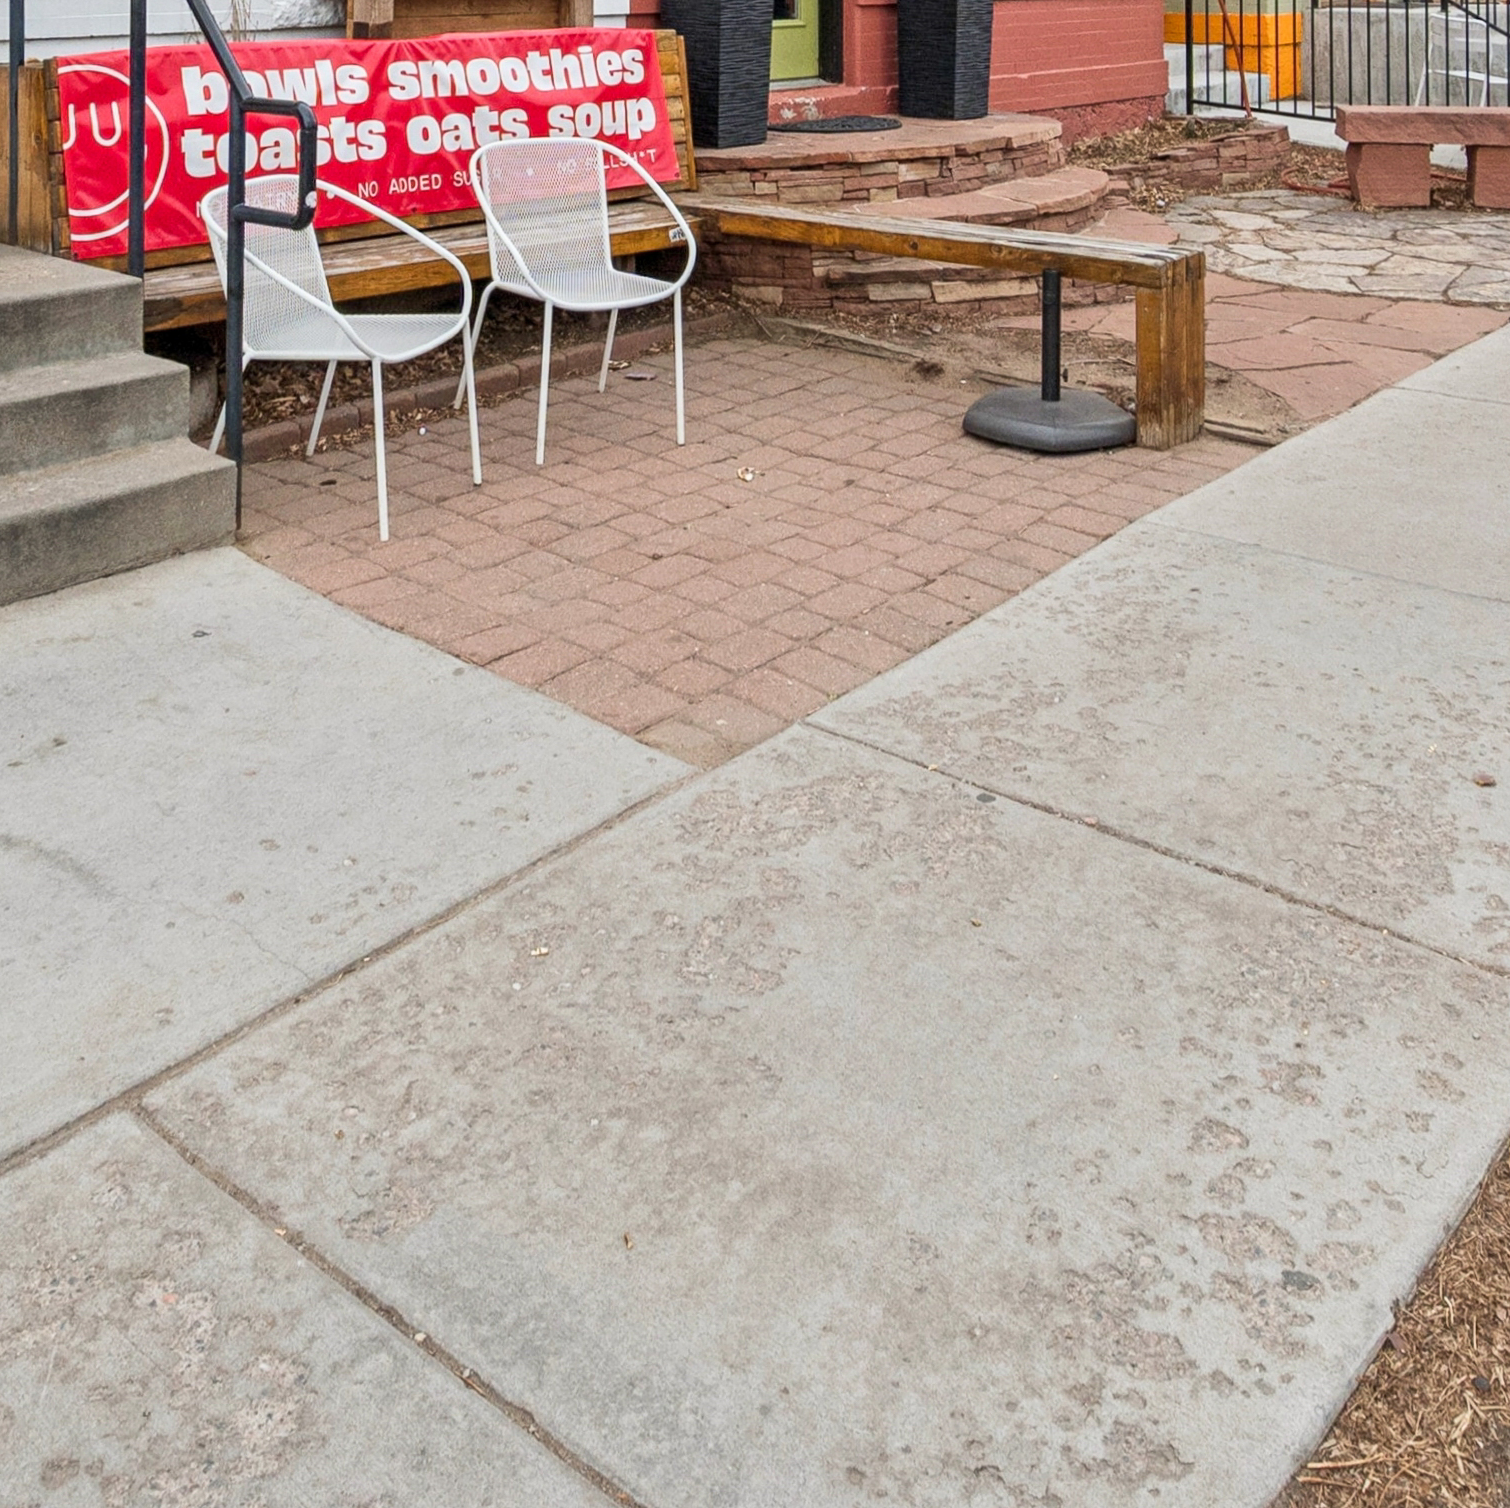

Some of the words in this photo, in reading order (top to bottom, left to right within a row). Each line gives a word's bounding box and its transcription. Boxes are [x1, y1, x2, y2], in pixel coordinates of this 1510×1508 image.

[388, 45, 645, 102] smoothies
[406, 101, 531, 156] oats
[548, 98, 657, 141] soup
[357, 180, 379, 199] NO
[389, 173, 442, 195] ADDED
